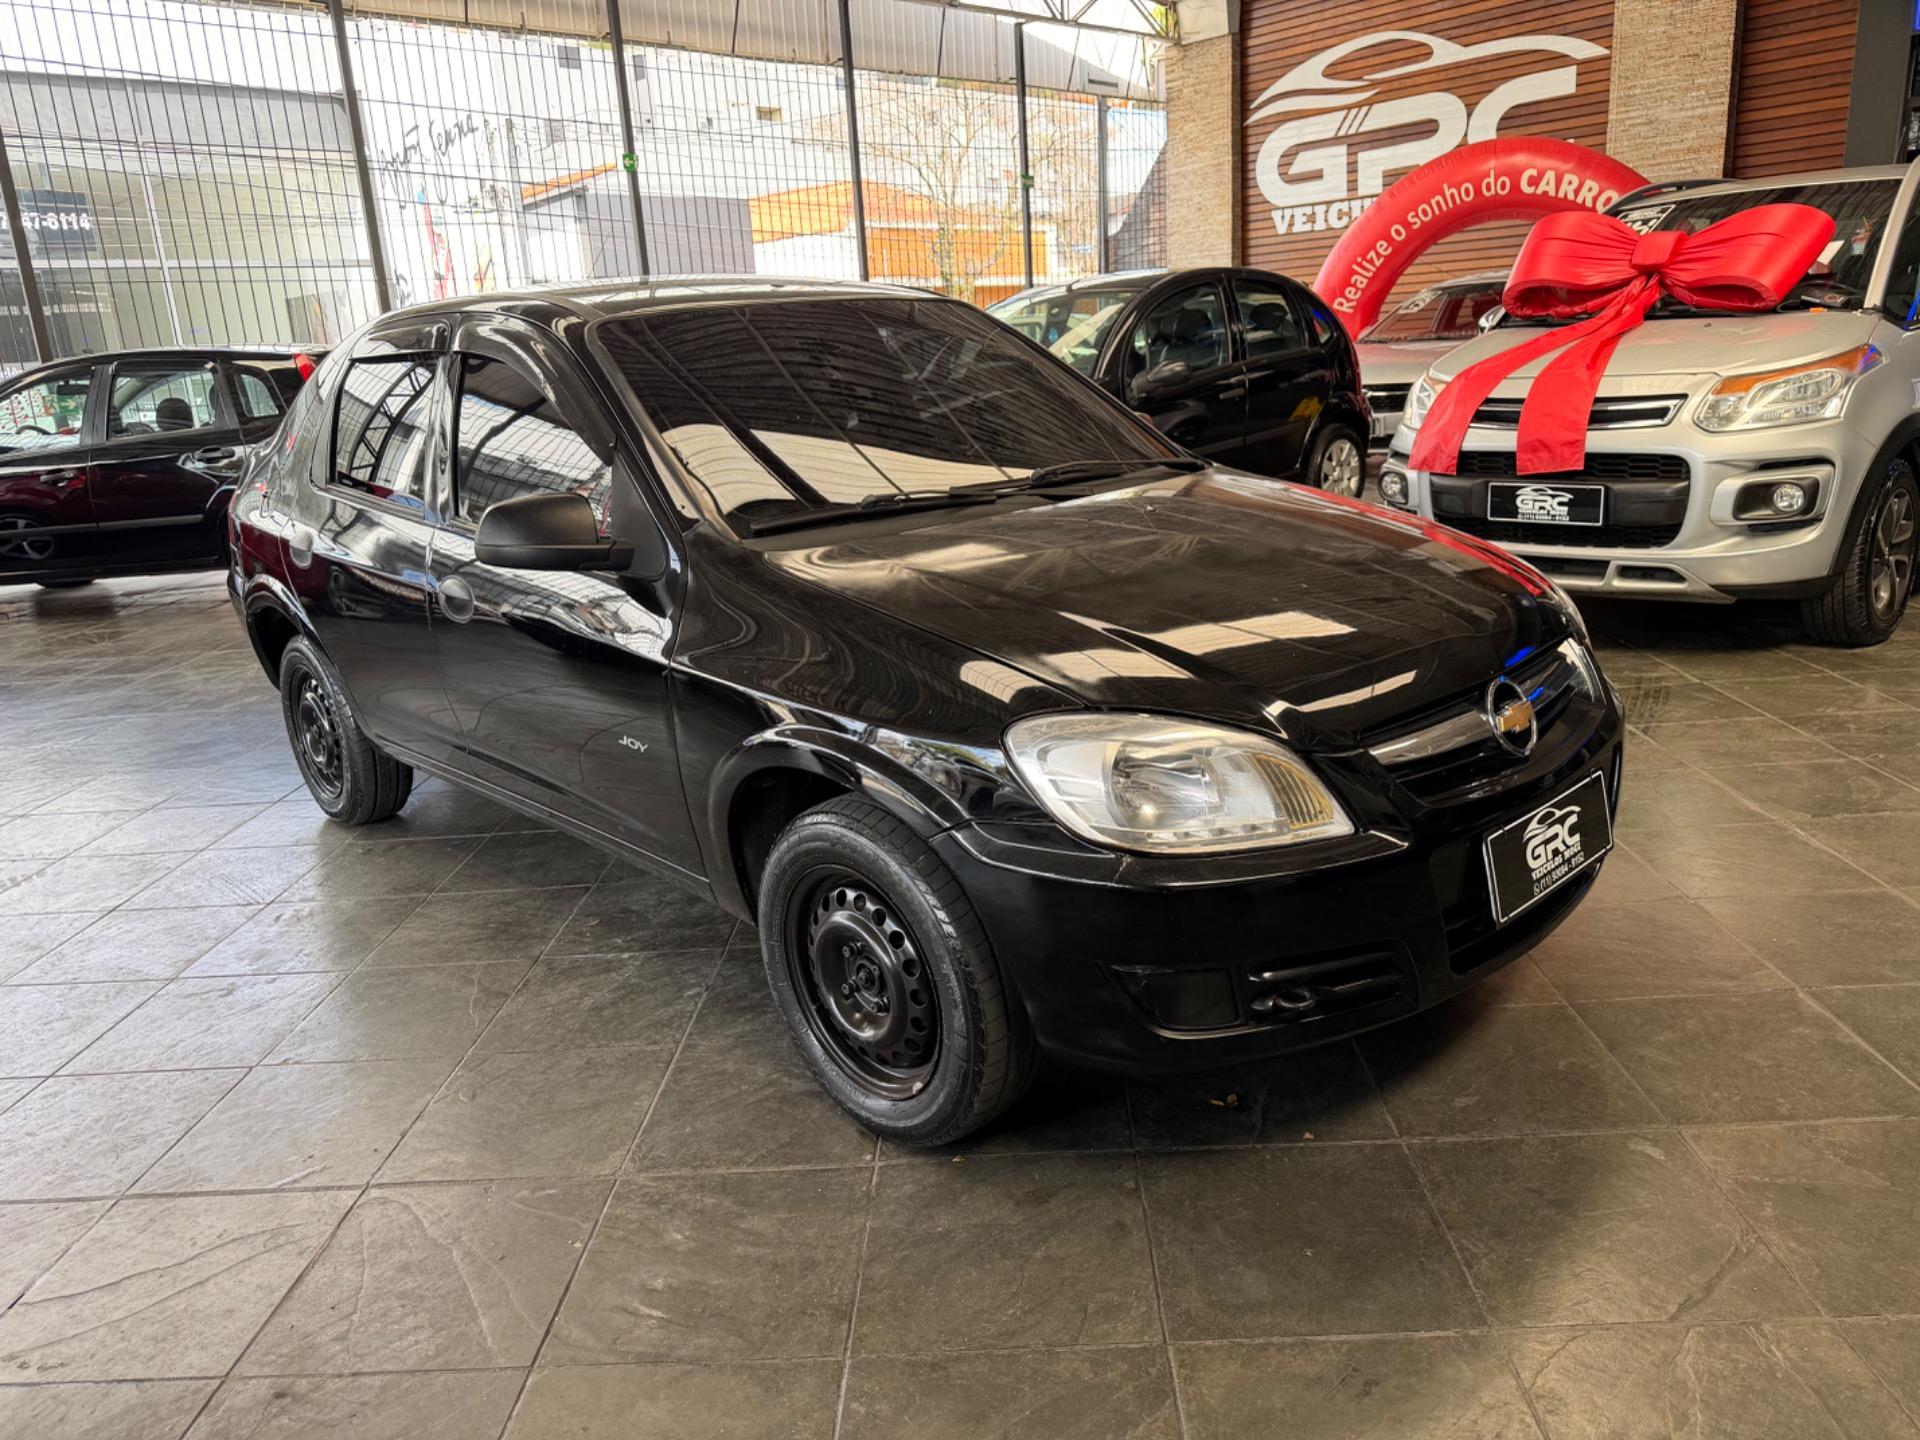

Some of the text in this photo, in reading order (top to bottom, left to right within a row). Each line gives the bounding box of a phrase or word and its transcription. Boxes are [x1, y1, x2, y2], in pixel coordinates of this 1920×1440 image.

[1333, 237, 1394, 314] Realize
[1390, 223, 1408, 243] o
[1406, 178, 1476, 231] sonho
[1482, 169, 1512, 197] do
[618, 735, 649, 753] JOY
[1526, 813, 1581, 870] GRC
